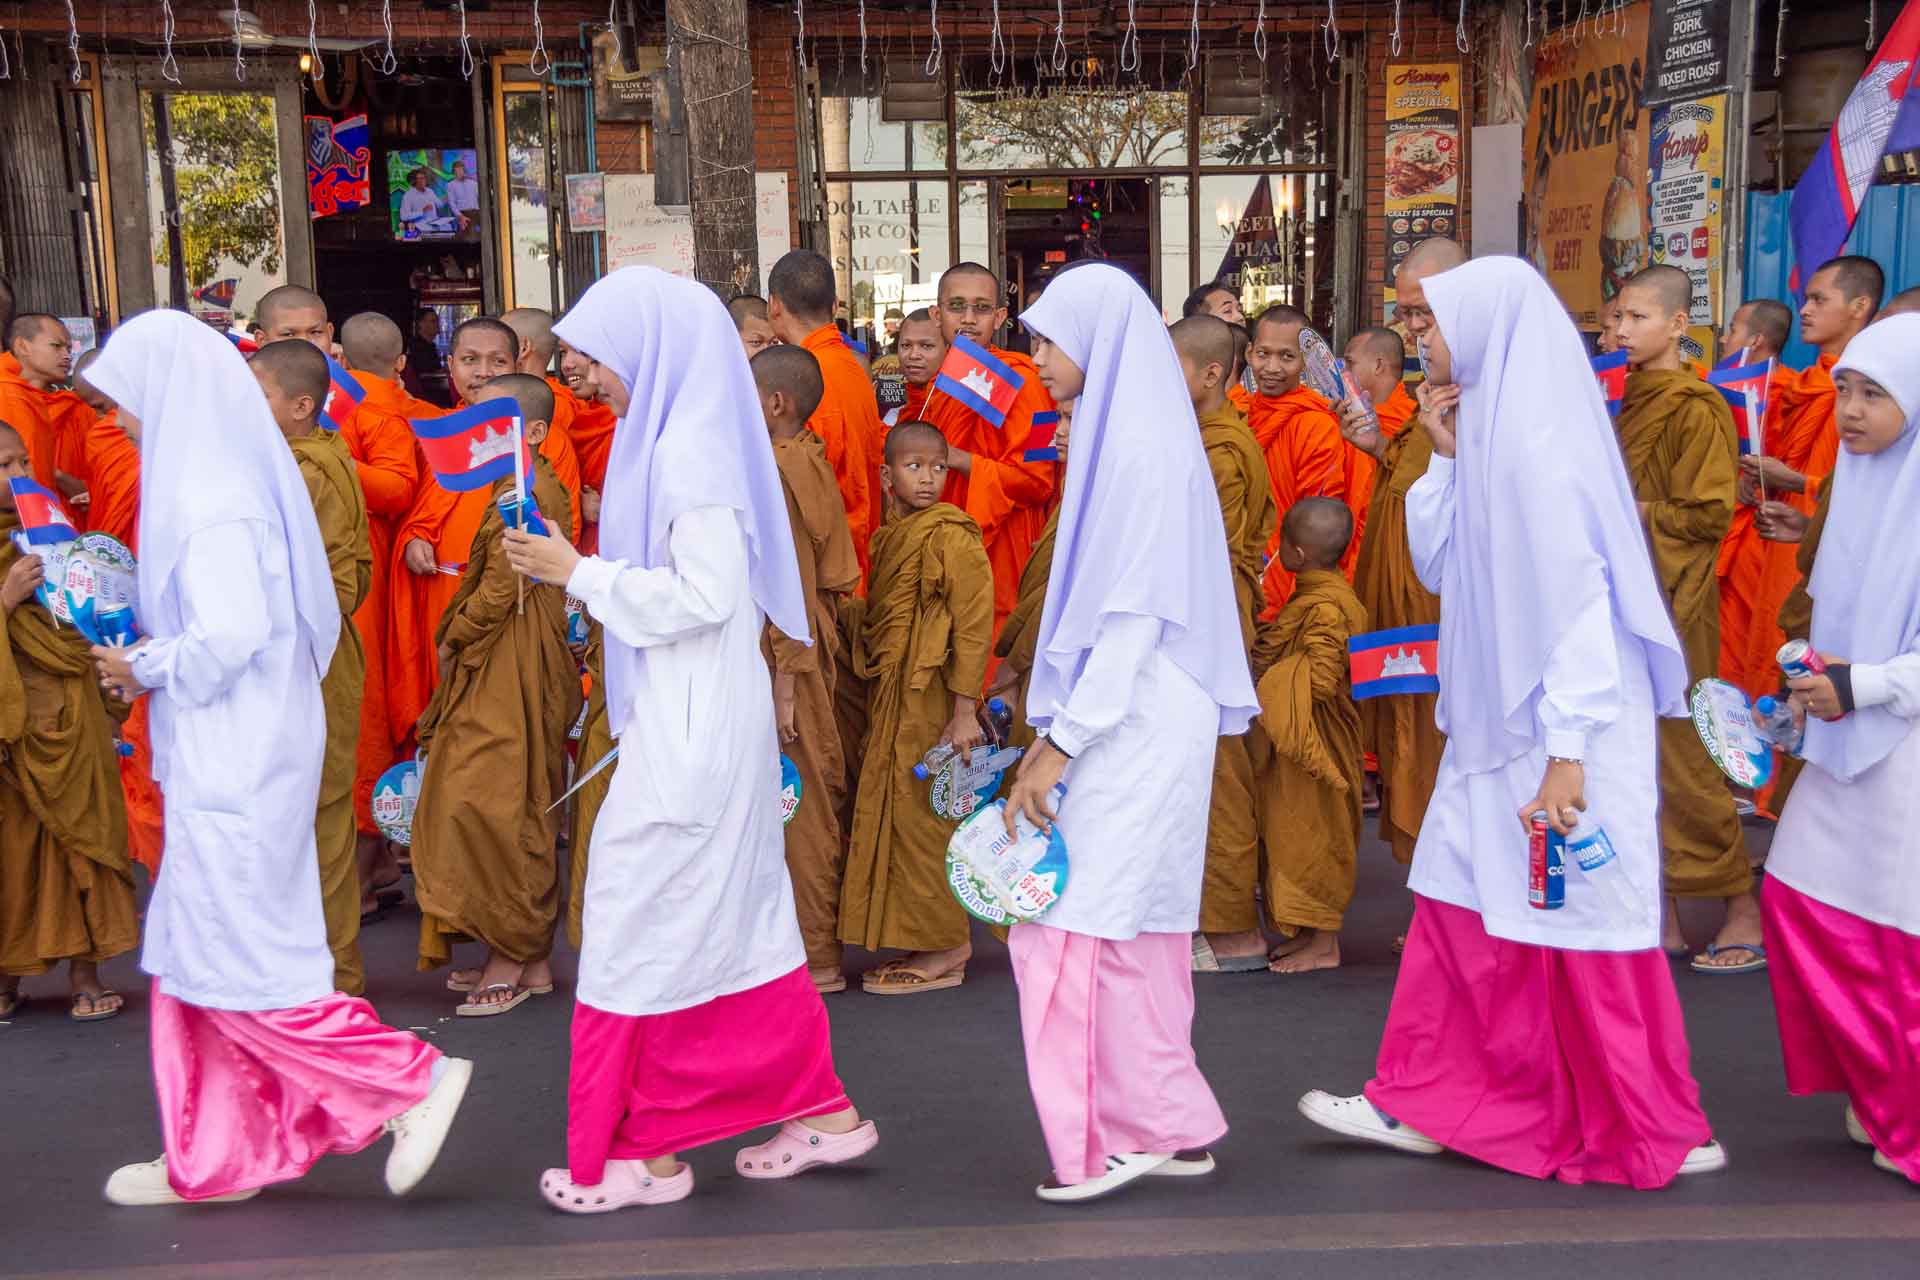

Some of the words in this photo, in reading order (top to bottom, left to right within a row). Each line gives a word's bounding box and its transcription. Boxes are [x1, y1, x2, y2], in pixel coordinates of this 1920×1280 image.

[1673, 16, 1703, 35] PORK
[1665, 38, 1712, 61] CHICKEN
[1688, 61, 1721, 81] ROAST
[1394, 96, 1453, 108] SPECIALS
[827, 199, 869, 216] OOL
[873, 198, 941, 216] TABLE
[1420, 208, 1454, 217] SPECIALS
[1233, 240, 1301, 258] PLACE
[1670, 238, 1687, 251] AFL
